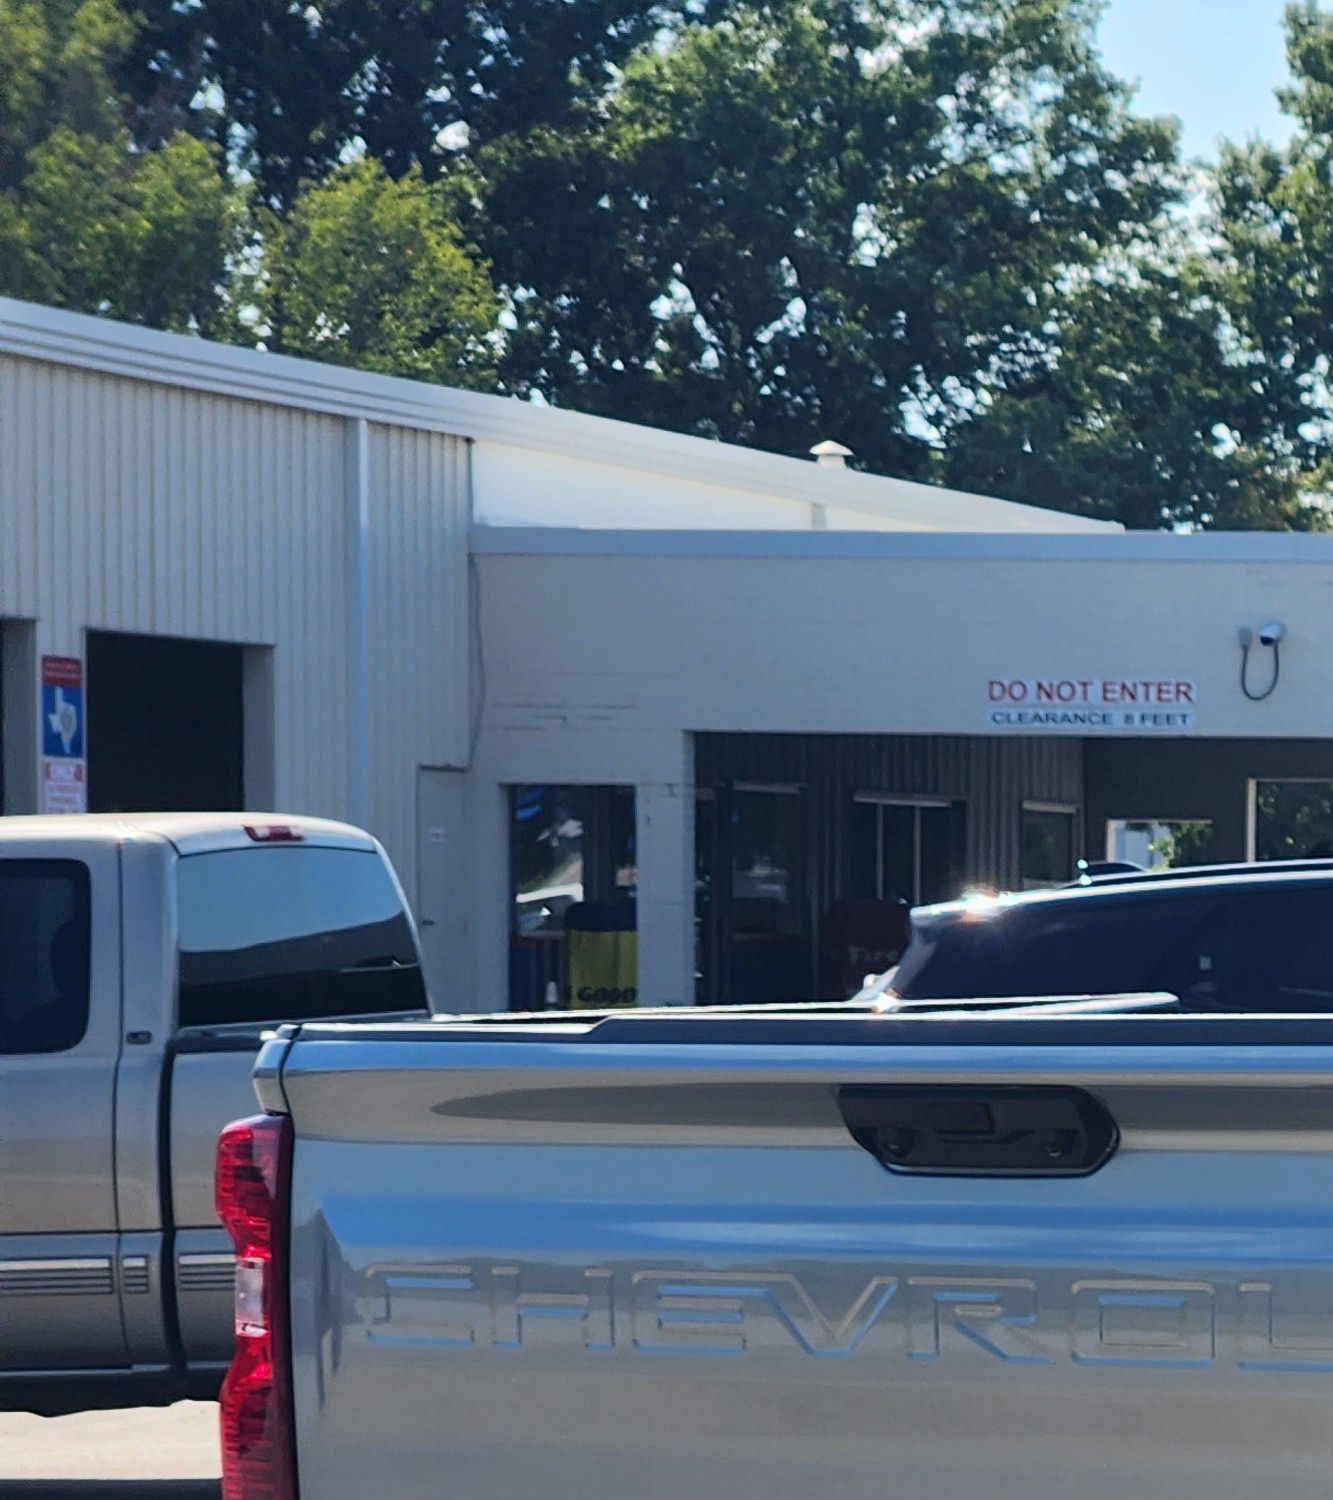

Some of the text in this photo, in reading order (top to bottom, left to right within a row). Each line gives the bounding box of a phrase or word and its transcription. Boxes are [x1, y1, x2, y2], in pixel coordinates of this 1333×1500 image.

[987, 680, 1194, 702] DO NOT ENTER
[991, 711, 1113, 725] CLEARANCE
[1141, 712, 1190, 725] FEET
